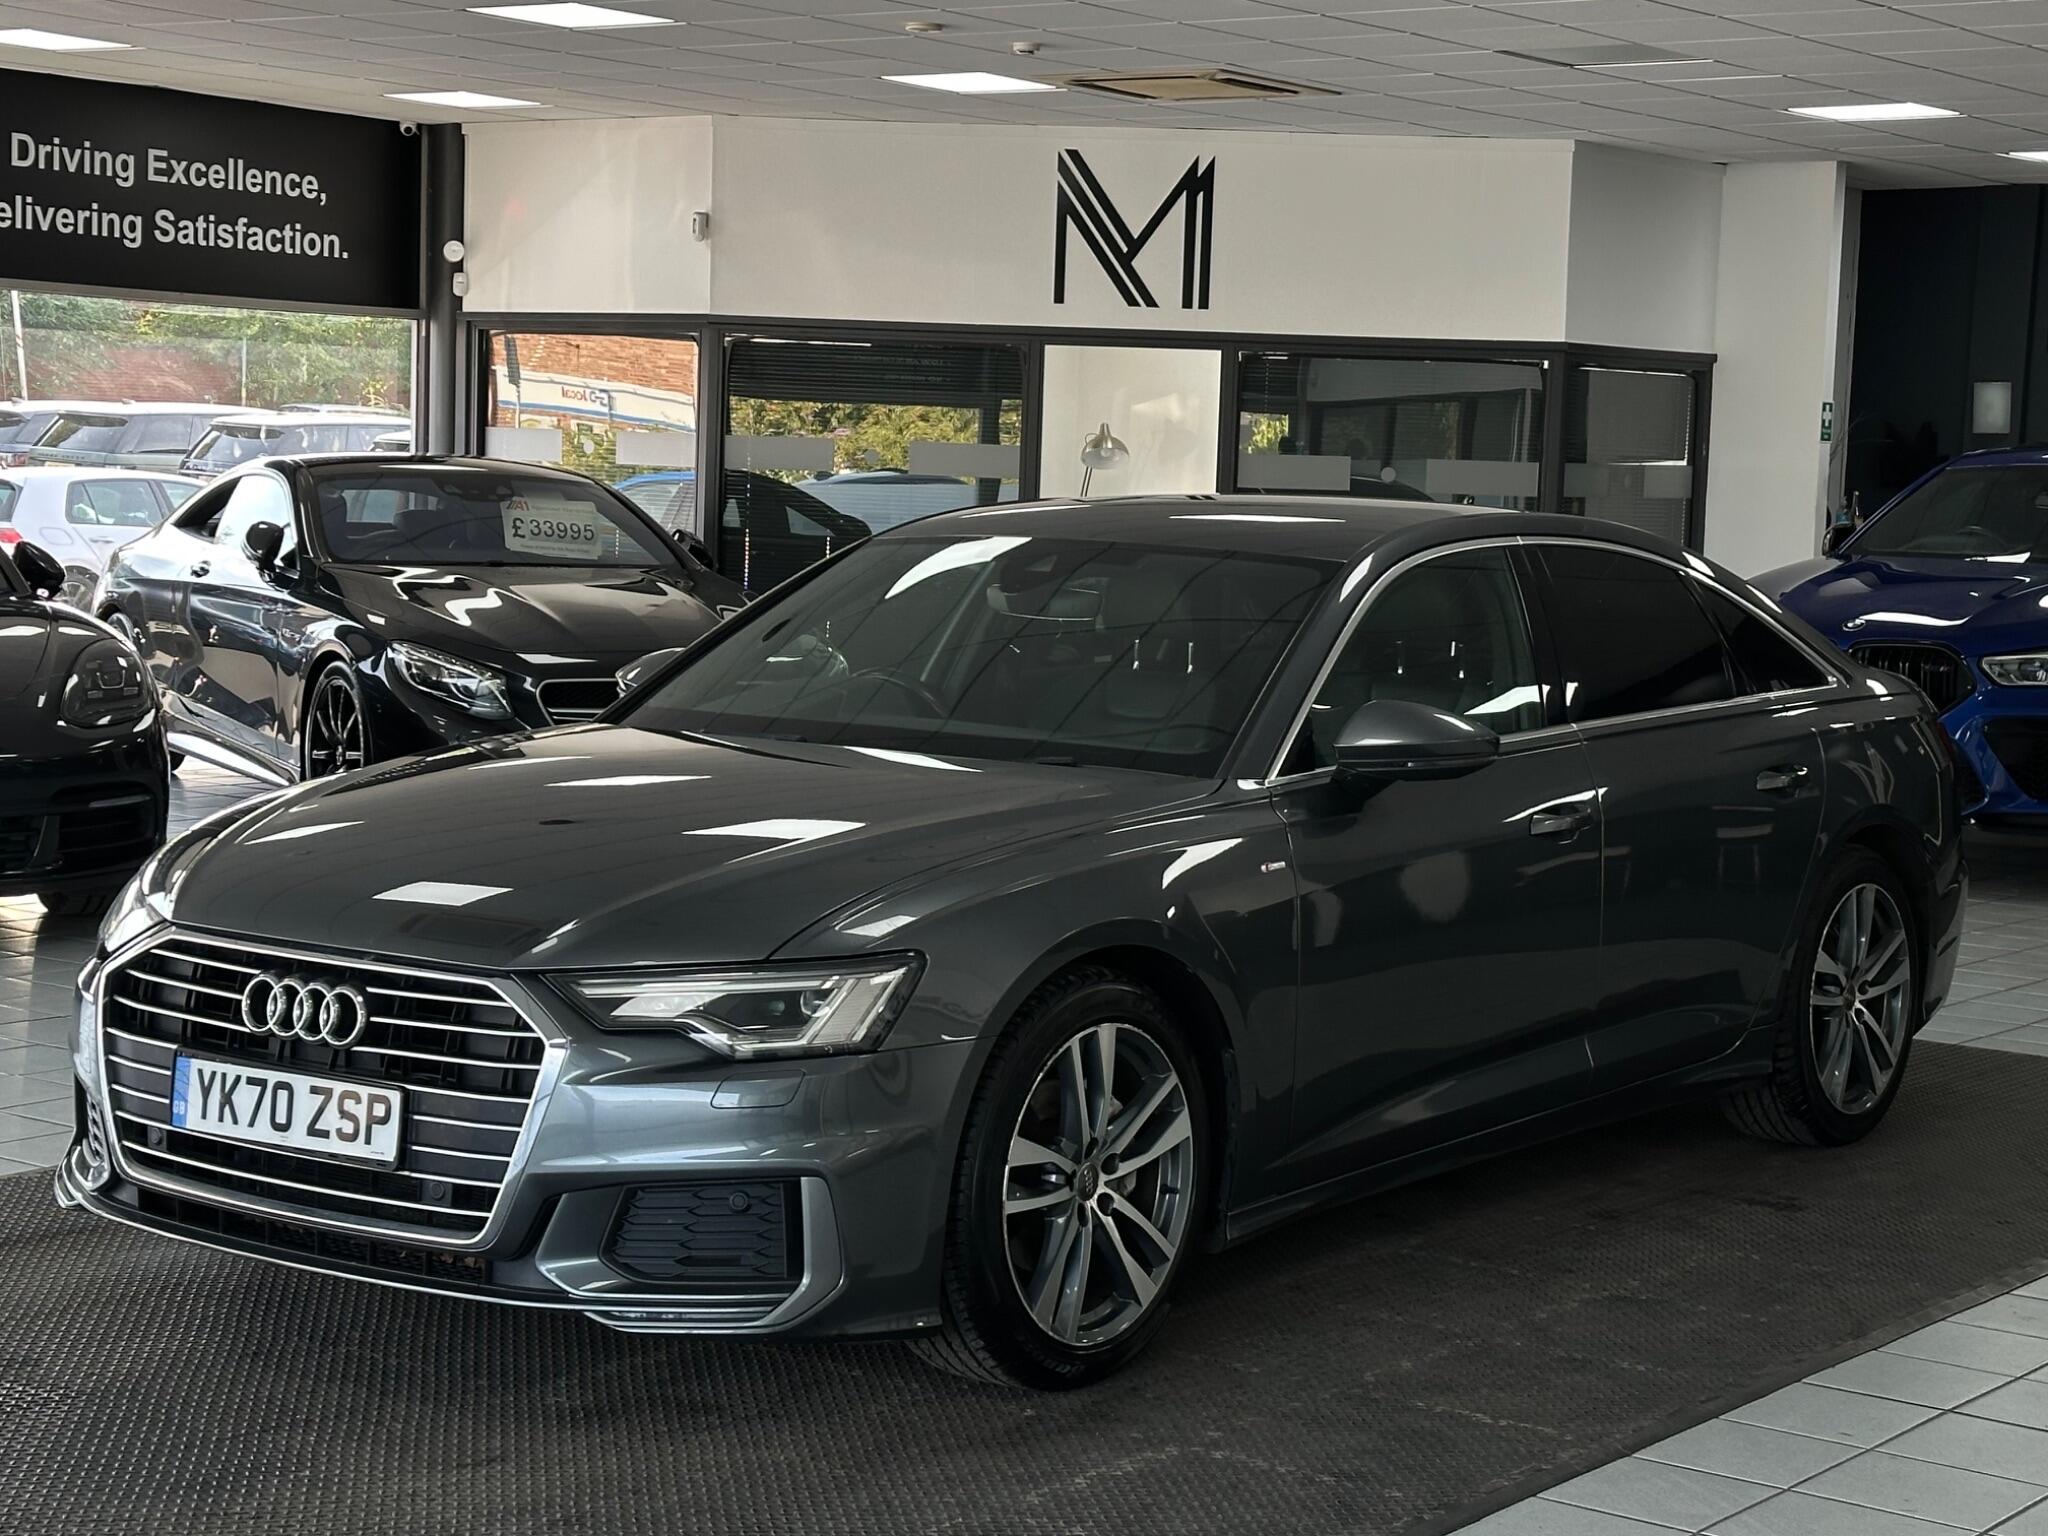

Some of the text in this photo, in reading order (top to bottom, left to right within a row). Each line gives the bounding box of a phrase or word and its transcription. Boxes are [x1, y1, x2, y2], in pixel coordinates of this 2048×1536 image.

[10, 132, 328, 206] Driving Excellence,
[0, 195, 350, 260] elivering Satisfaction.
[172, 1099, 185, 1116] GB
[197, 1067, 393, 1146] YK70 ZSP
